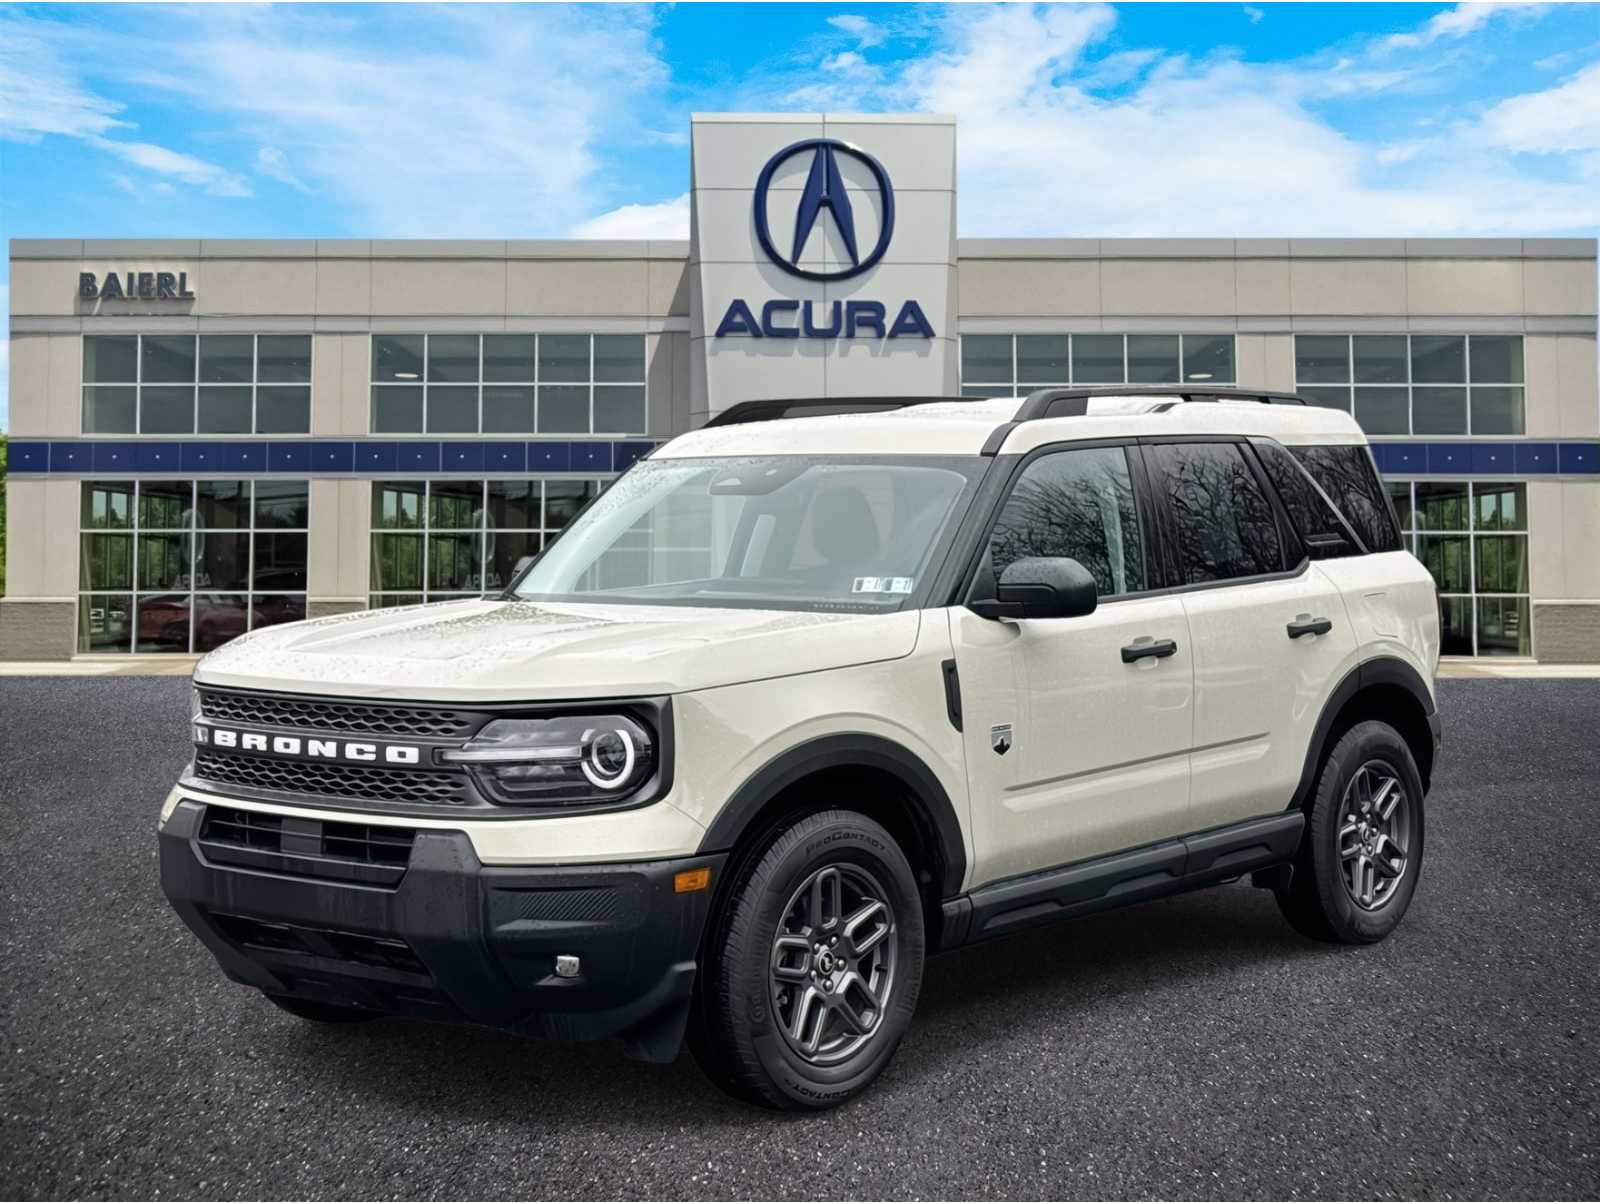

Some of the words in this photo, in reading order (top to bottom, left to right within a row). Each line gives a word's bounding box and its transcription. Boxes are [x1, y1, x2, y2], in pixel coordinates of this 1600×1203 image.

[79, 272, 195, 301] BAIERL
[715, 299, 936, 338] ACURA
[213, 729, 420, 764] BRONCO
